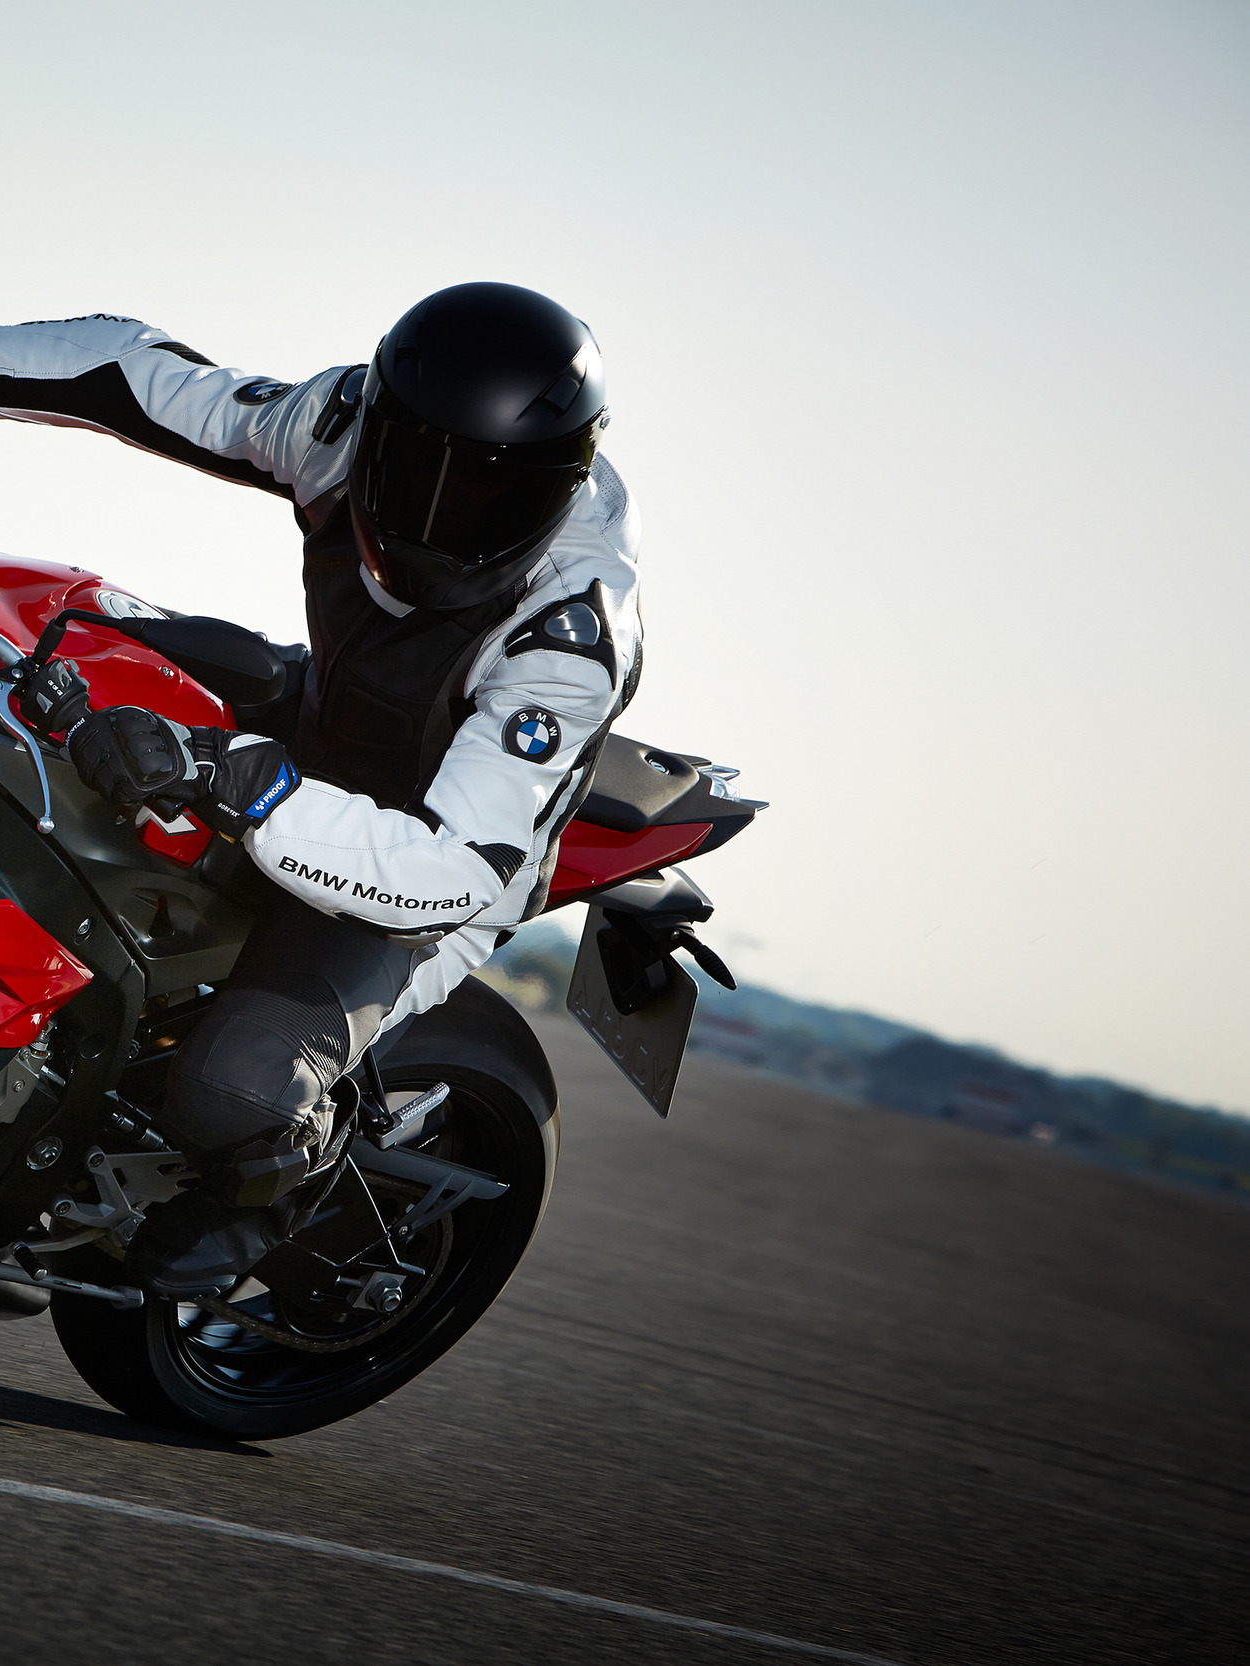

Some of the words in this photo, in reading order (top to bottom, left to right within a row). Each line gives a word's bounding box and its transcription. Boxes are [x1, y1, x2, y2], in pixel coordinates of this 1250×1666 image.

[518, 712, 558, 737] BMW
[263, 779, 286, 803] PROOF
[278, 856, 348, 892] BMW
[352, 882, 471, 911] Motorrad
